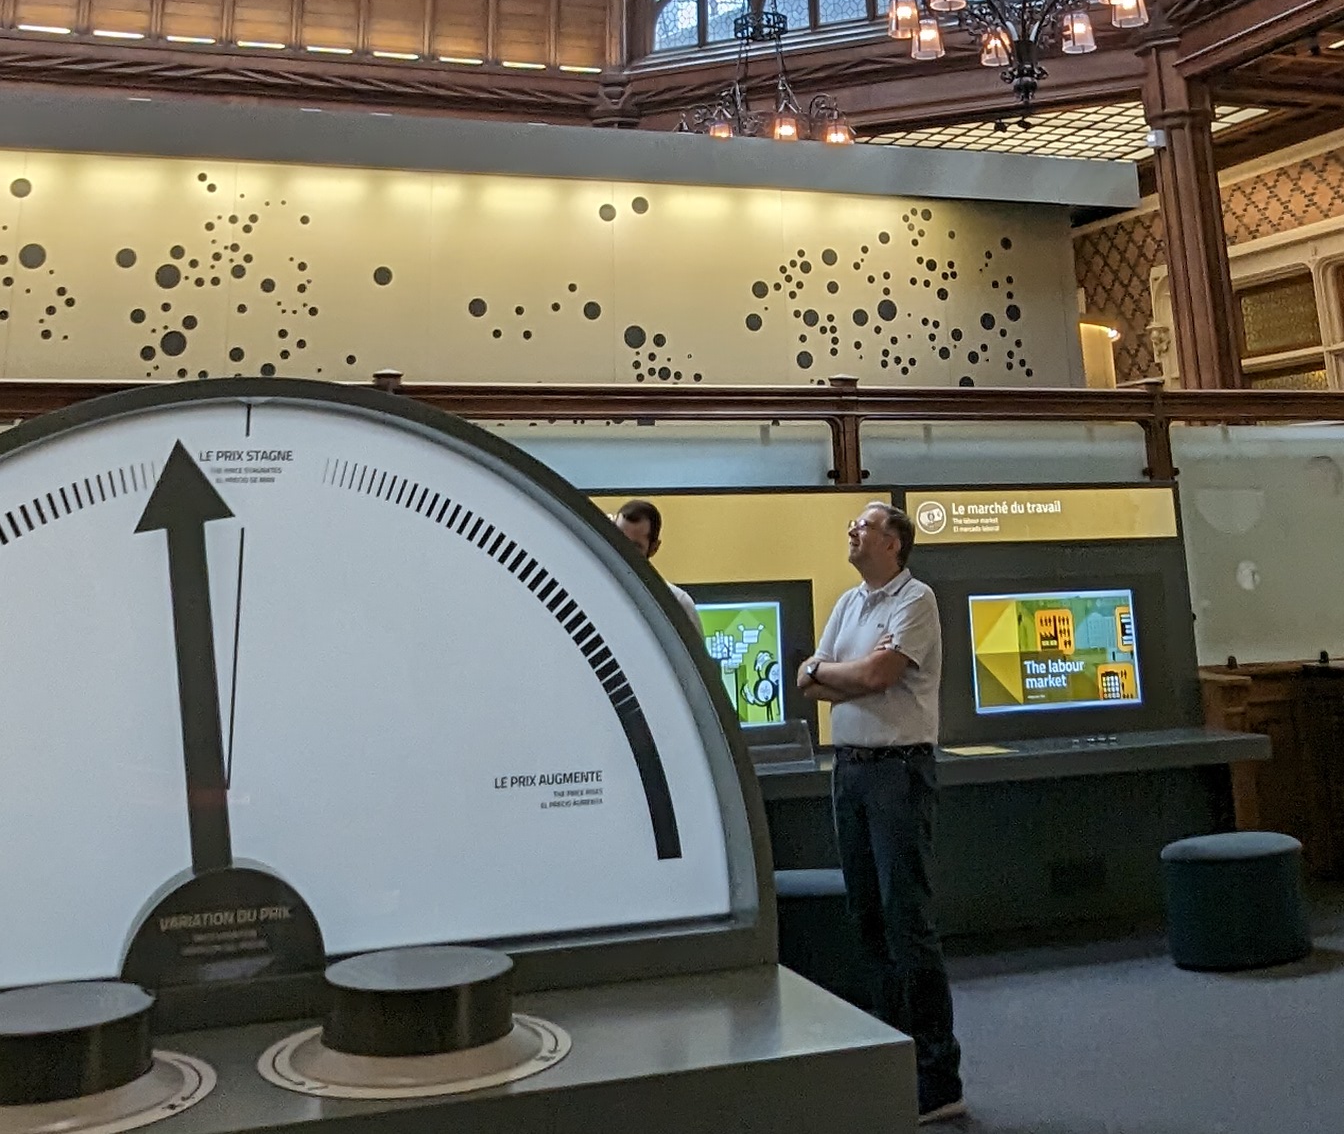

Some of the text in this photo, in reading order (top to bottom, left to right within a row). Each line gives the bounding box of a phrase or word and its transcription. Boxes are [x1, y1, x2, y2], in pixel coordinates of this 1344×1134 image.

[199, 450, 294, 462] LE PRIX STAGNE
[952, 500, 1061, 515] Le marché du travail
[1024, 659, 1084, 674] The labour
[1025, 674, 1067, 689] market
[494, 770, 603, 789] LE PRIX AUGMENTE
[160, 906, 291, 932] VARIATION DU PRIX
